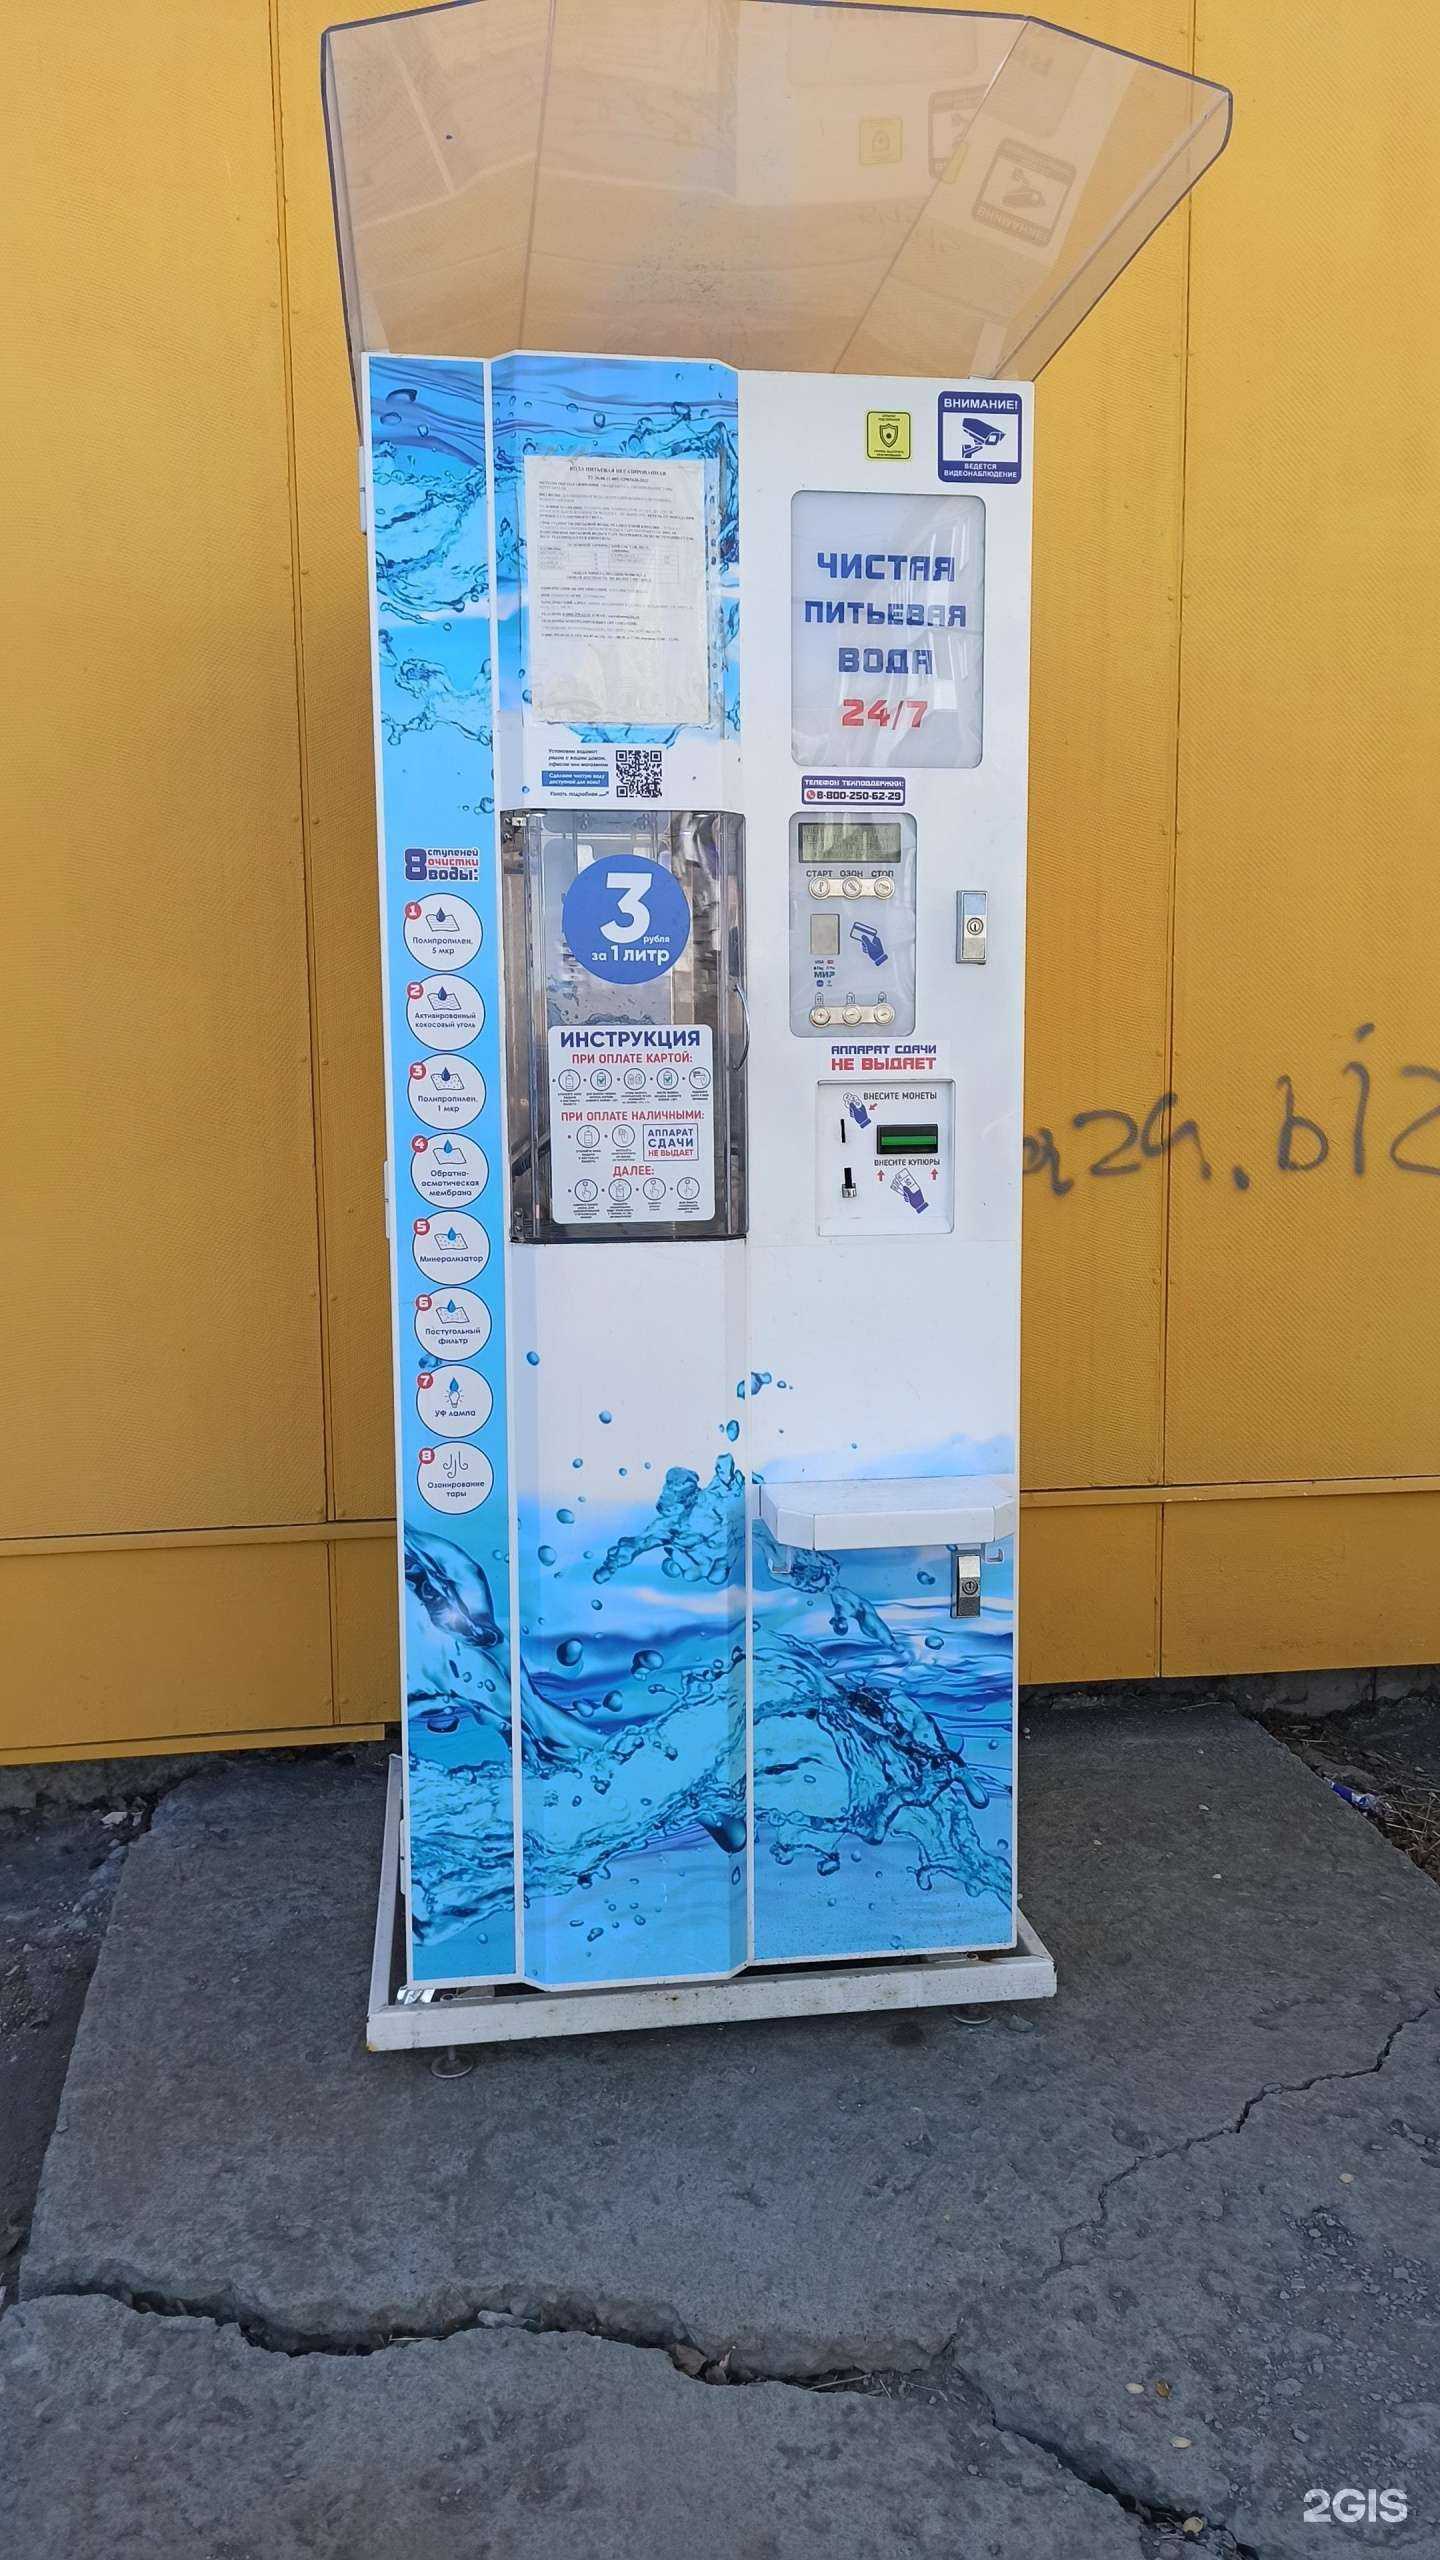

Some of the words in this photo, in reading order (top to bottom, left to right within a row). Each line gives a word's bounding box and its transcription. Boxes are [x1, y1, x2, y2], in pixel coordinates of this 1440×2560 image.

[944, 398, 1018, 410] ВНИМАНИЕ!
[944, 470, 1017, 478] ВИДЕОНАБЛЮДЕНИЕ
[817, 552, 955, 582] ЧИСТАЯ
[804, 600, 967, 627] ПИТЬЕВАЯ
[838, 647, 933, 675] ВОДА
[842, 699, 928, 730] 24/7
[405, 849, 427, 880] 8
[428, 858, 479, 866] очистки
[428, 867, 478, 880] воды:
[409, 905, 418, 916] 1
[600, 872, 652, 944] 3
[643, 934, 670, 945] рубля
[591, 952, 607, 961] за
[610, 945, 618, 961] 1
[623, 950, 670, 966] литр
[410, 986, 420, 996] 2
[415, 1012, 476, 1020] Активированный
[560, 1030, 700, 1049] ИНСТРУКЦИЯ
[831, 1045, 890, 1055] АППАРАТ
[894, 1044, 936, 1054] СДАЧИ
[572, 1054, 595, 1064] ПРИ
[599, 1053, 642, 1064] ОПЛАТЕ
[646, 1051, 693, 1063] КАРТОЙ:
[831, 1058, 854, 1071] НЕ
[861, 1057, 936, 1070] ВЫДАЕТ
[413, 1066, 423, 1076] 3
[863, 1092, 899, 1100] ВНЕСИТЕ
[902, 1092, 937, 1100] МОНЕТЫ
[561, 1112, 583, 1121] ПРИ
[586, 1111, 628, 1121] ОПЛАТЕ
[631, 1110, 704, 1121] НАЛИЧНЫМИ:
[648, 1128, 693, 1137] АППАРАТ
[415, 1138, 425, 1149] 4
[648, 1139, 693, 1149] СДАЧИ
[874, 1159, 906, 1167] ВНЕСИТЕ
[430, 1170, 469, 1178] Обратно-
[612, 1165, 655, 1178] ДАЛЕЕ:
[429, 1189, 472, 1197] мембрана
[416, 1221, 426, 1232] 5
[420, 1255, 483, 1263] Минерализатор
[419, 1298, 429, 1307] 6
[425, 1327, 481, 1336] Постугольный
[438, 1337, 468, 1345] фильтр
[420, 1376, 430, 1386] 7
[422, 1452, 432, 1461] 8
[427, 1480, 485, 1489] Озонирование
